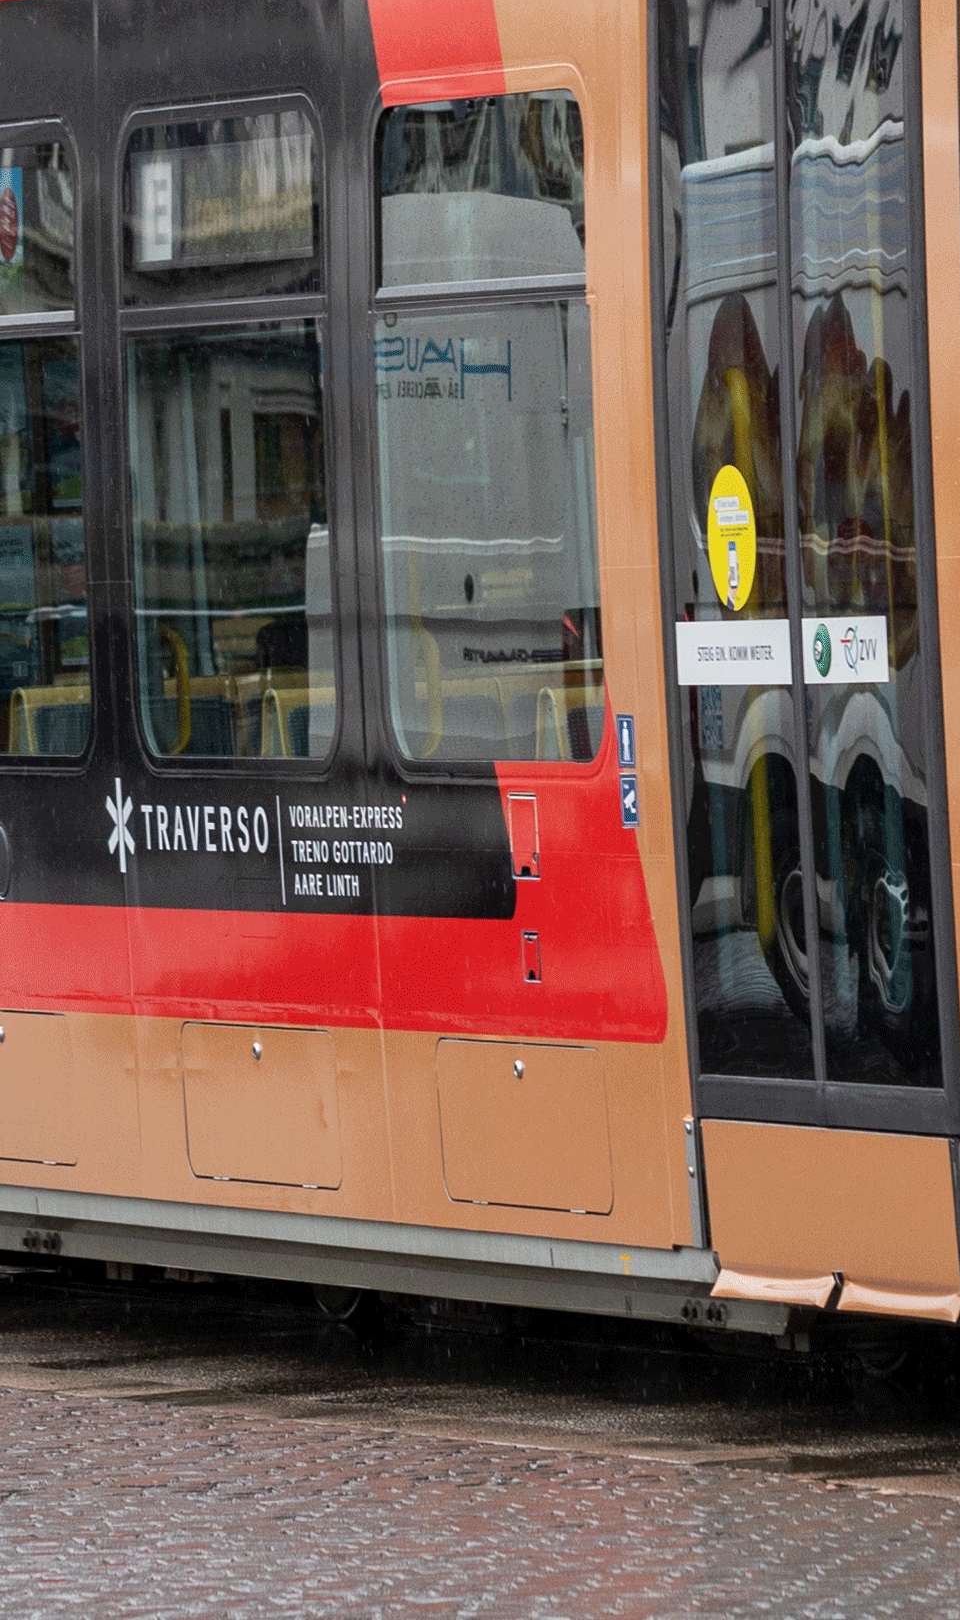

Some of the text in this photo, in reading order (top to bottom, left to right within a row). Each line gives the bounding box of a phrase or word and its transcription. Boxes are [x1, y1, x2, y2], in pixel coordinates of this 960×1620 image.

[697, 646, 714, 662] STEIG
[729, 645, 749, 661] KOMM
[859, 638, 878, 661] ZVV
[141, 804, 269, 854] TRAVERSO
[288, 805, 403, 830] VORALPEN-EXPRESS
[291, 840, 394, 865] TRENO GOTTARDO
[294, 873, 360, 898] AARE LINTH
